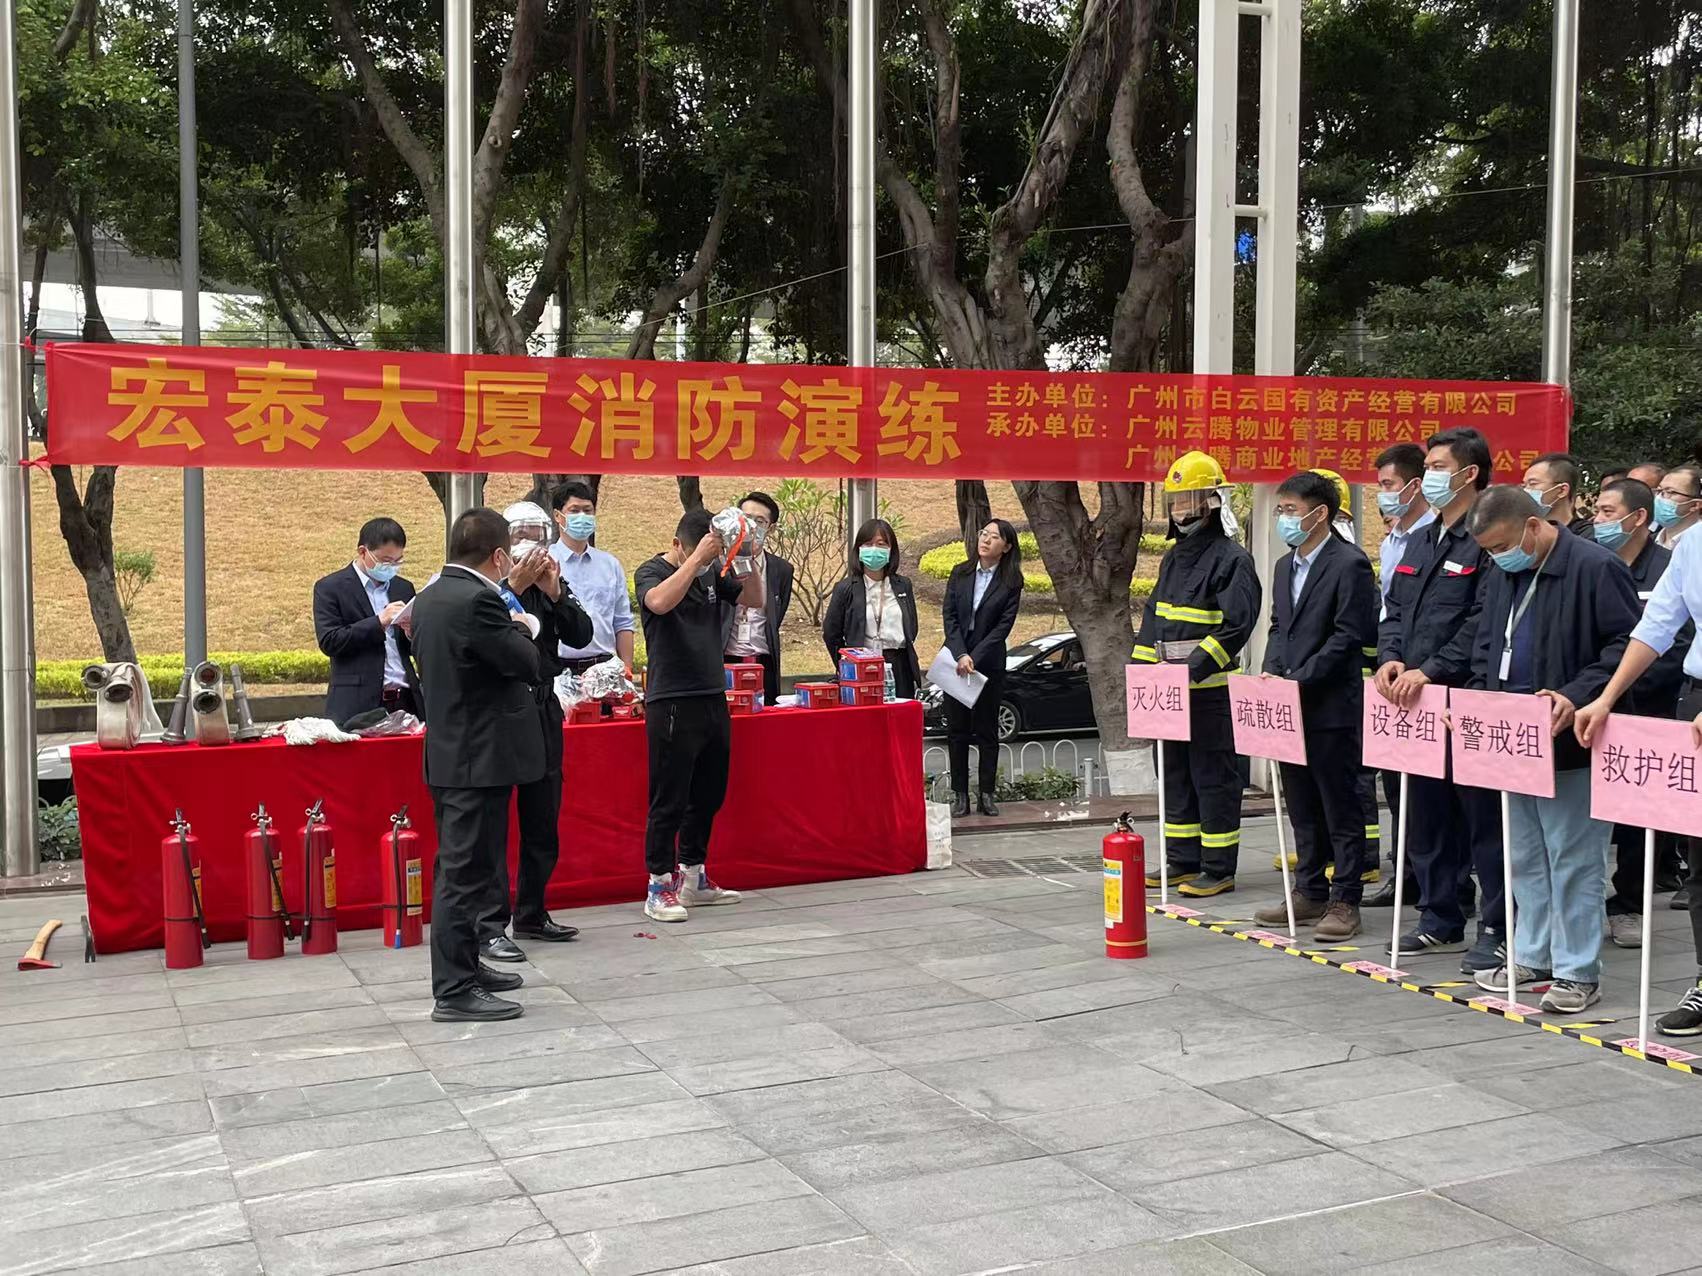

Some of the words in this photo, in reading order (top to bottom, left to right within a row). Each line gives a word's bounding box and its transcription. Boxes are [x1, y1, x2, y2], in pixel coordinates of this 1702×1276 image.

[107, 357, 962, 464] 宏泰大厦消防演练
[1132, 685, 1184, 712] 灭火组
[1236, 696, 1296, 733] 疏散组
[1370, 703, 1437, 743] 设备组
[1459, 715, 1543, 759] 警戒组
[1601, 743, 1699, 794] 救护组
